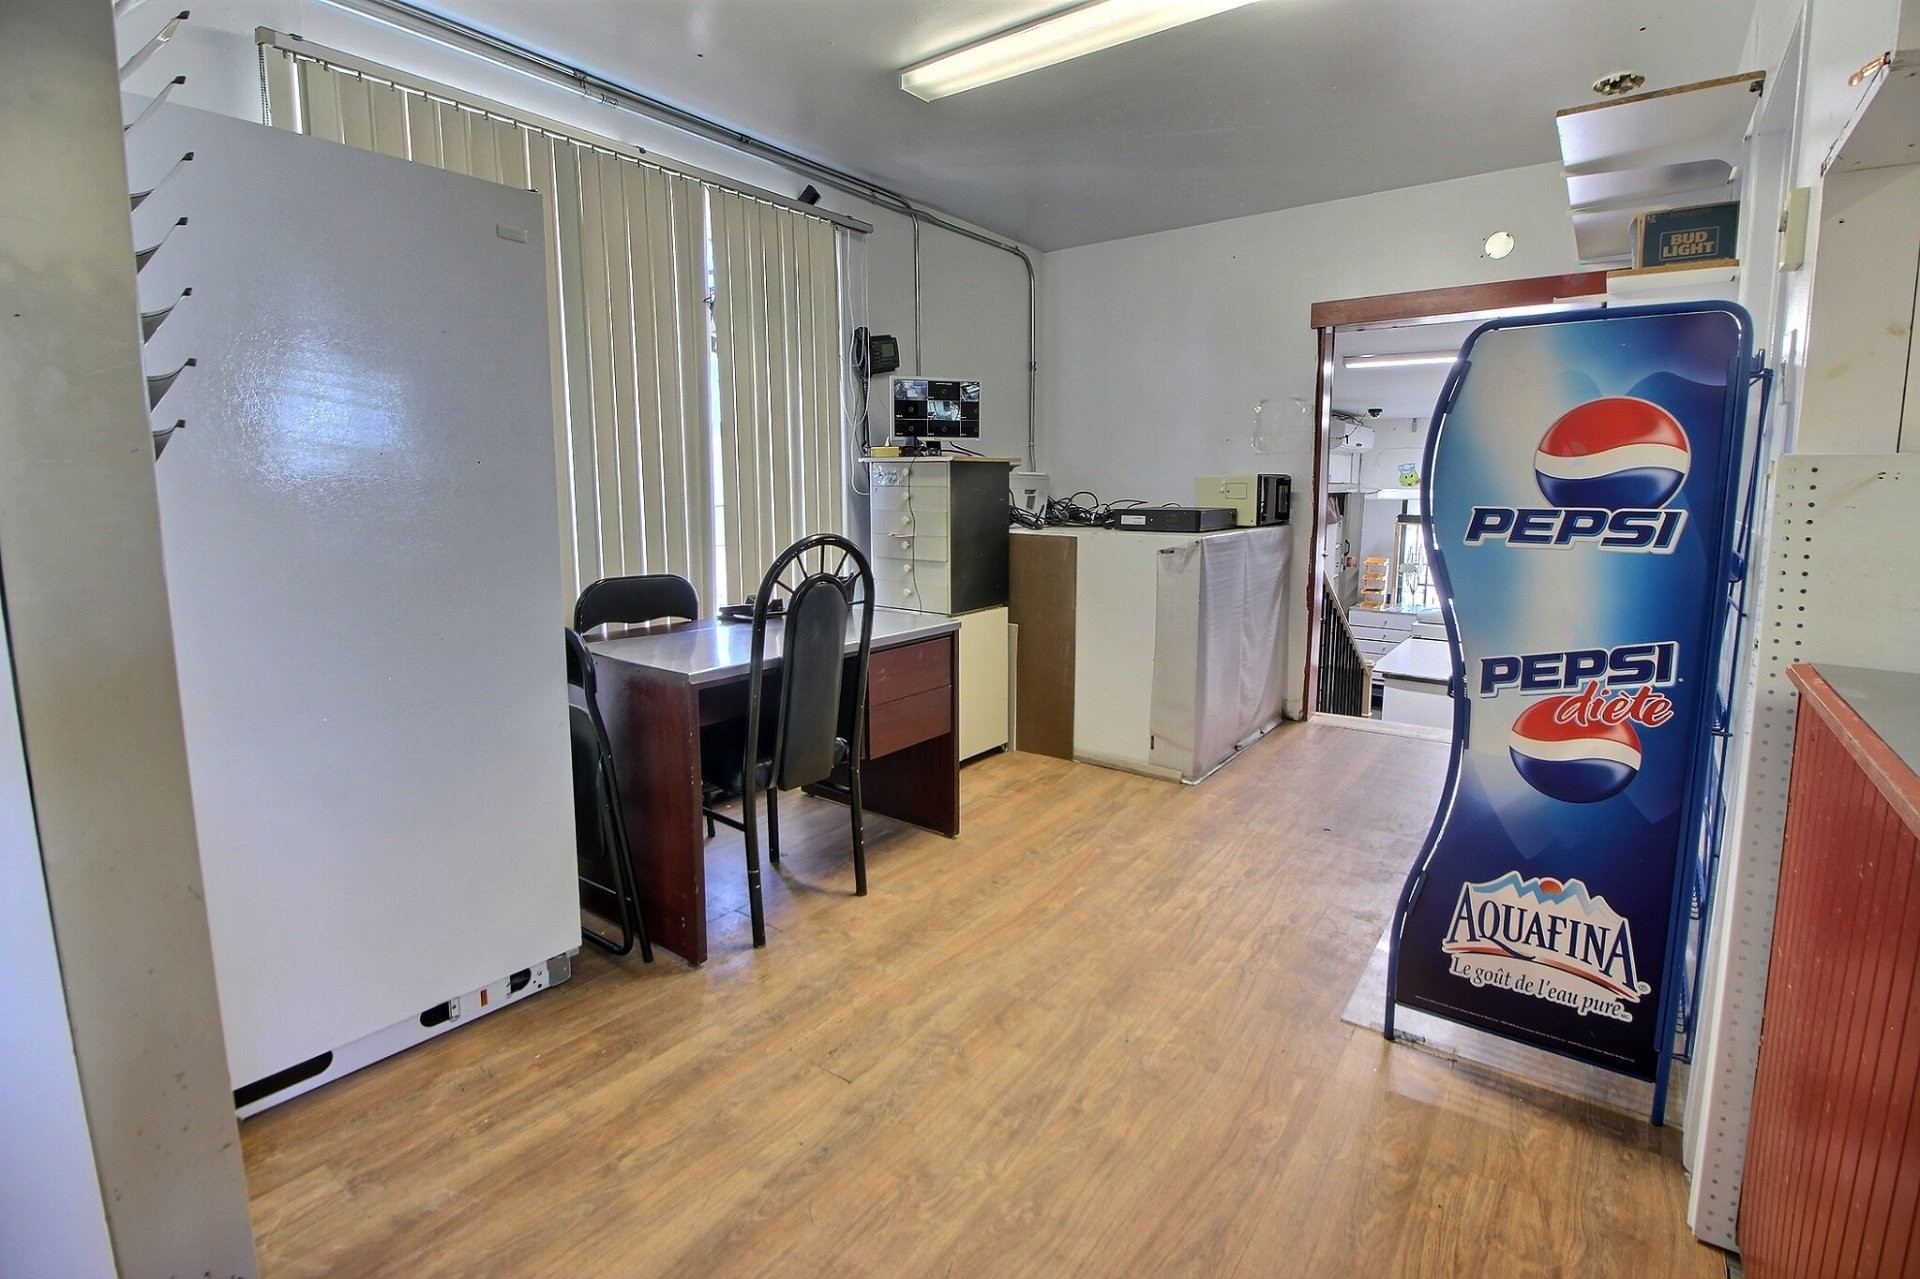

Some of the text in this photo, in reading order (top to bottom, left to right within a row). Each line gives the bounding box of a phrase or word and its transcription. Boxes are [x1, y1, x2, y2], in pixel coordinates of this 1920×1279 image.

[1663, 241, 1714, 257] LIGHT
[1670, 231, 1708, 245] BUD
[1464, 506, 1688, 554] PEPSI
[1479, 641, 1679, 698] PEPSI
[1554, 680, 1674, 727] diète
[1445, 885, 1639, 992] AQUAFINA
[1452, 957, 1622, 1017] Le goût de l'eau pure
